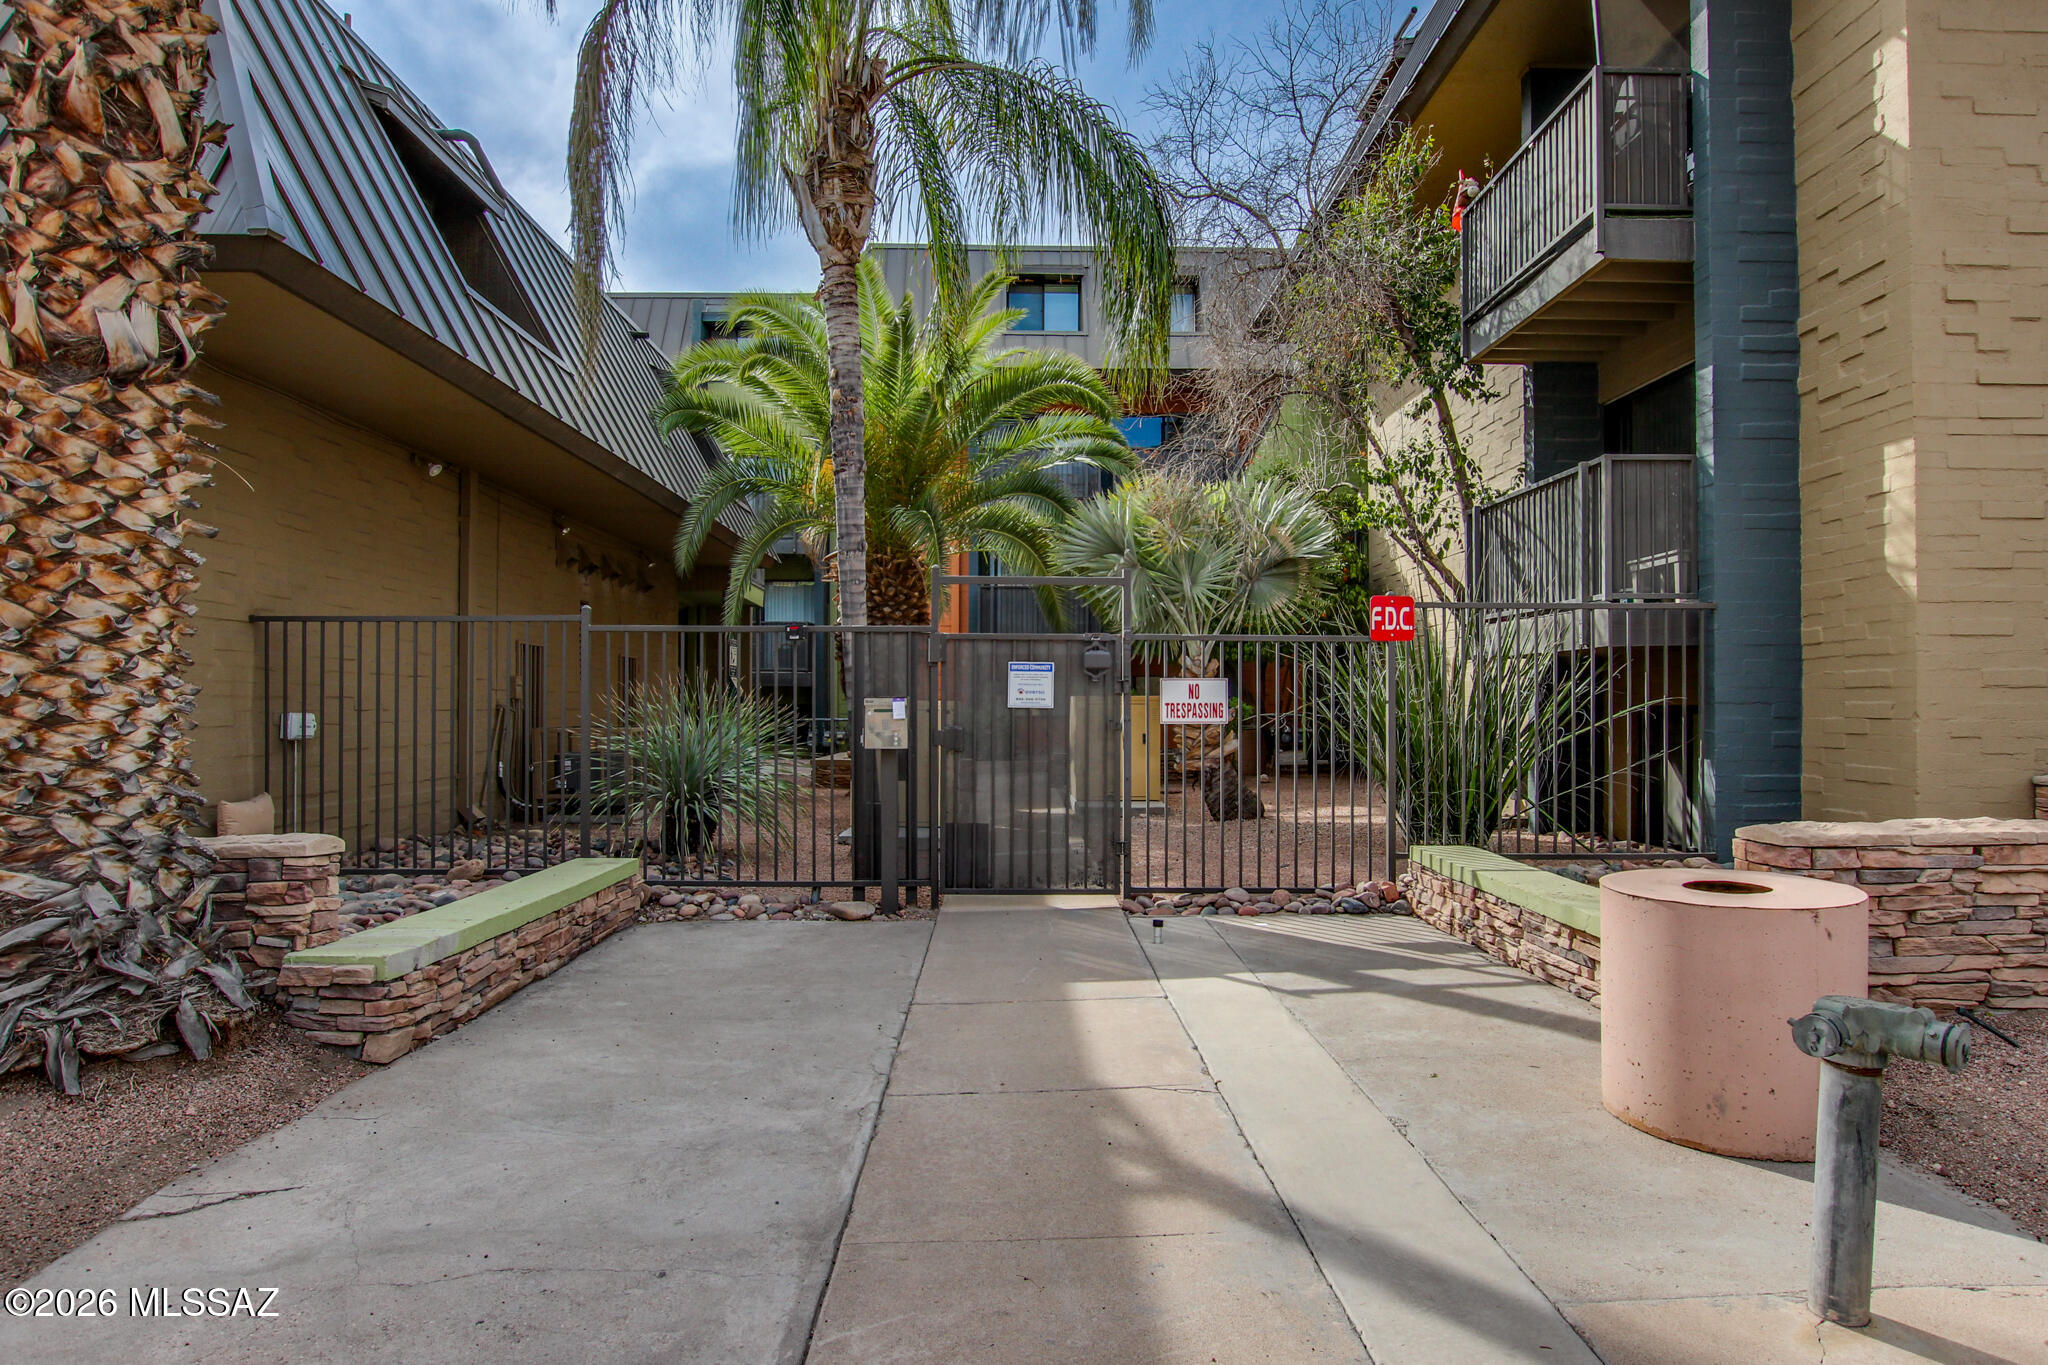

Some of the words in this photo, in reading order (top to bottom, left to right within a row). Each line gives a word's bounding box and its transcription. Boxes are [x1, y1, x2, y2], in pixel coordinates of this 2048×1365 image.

[1371, 606, 1414, 631] F.D.C.
[1188, 683, 1200, 700] NO
[1164, 702, 1224, 719] TRESPASSING
